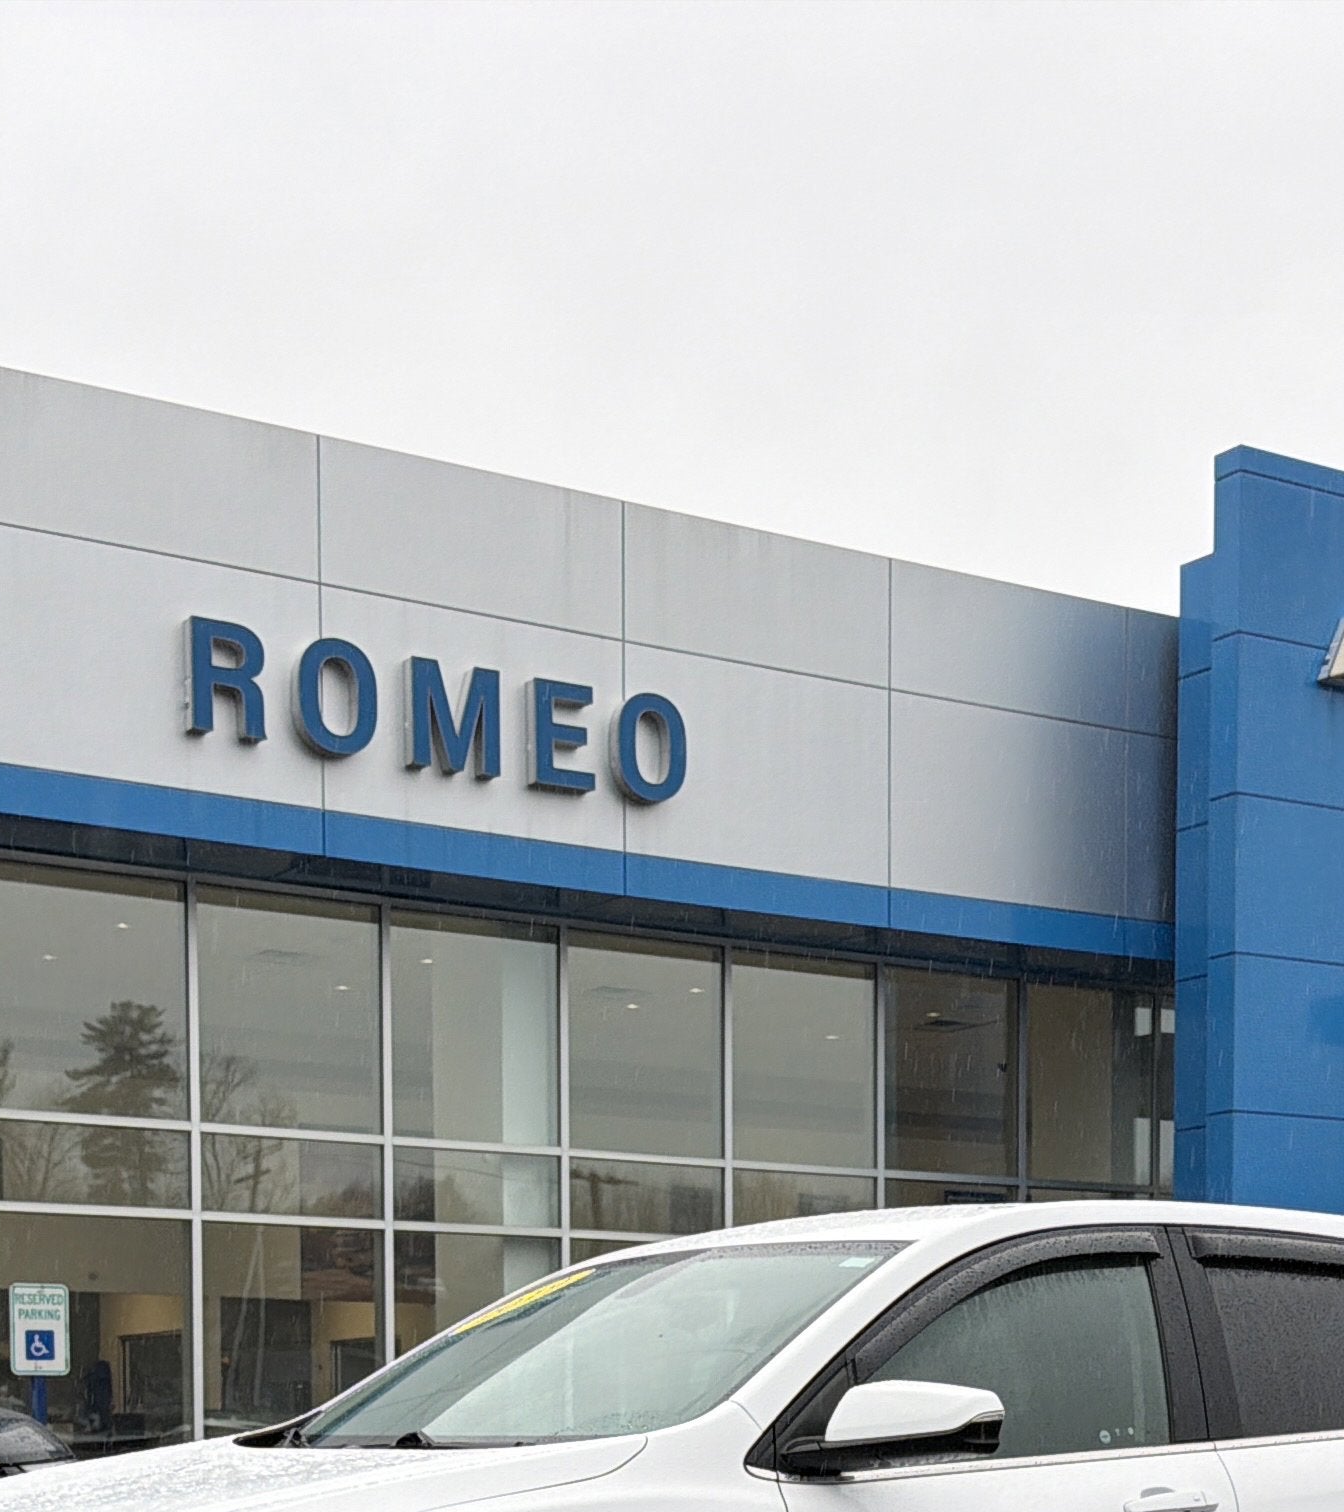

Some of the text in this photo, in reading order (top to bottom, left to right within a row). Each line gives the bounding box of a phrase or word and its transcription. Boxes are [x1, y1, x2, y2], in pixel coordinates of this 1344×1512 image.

[183, 615, 687, 806] ROMEO
[14, 1293, 65, 1306] RESERVED
[17, 1308, 61, 1321] PARKING
